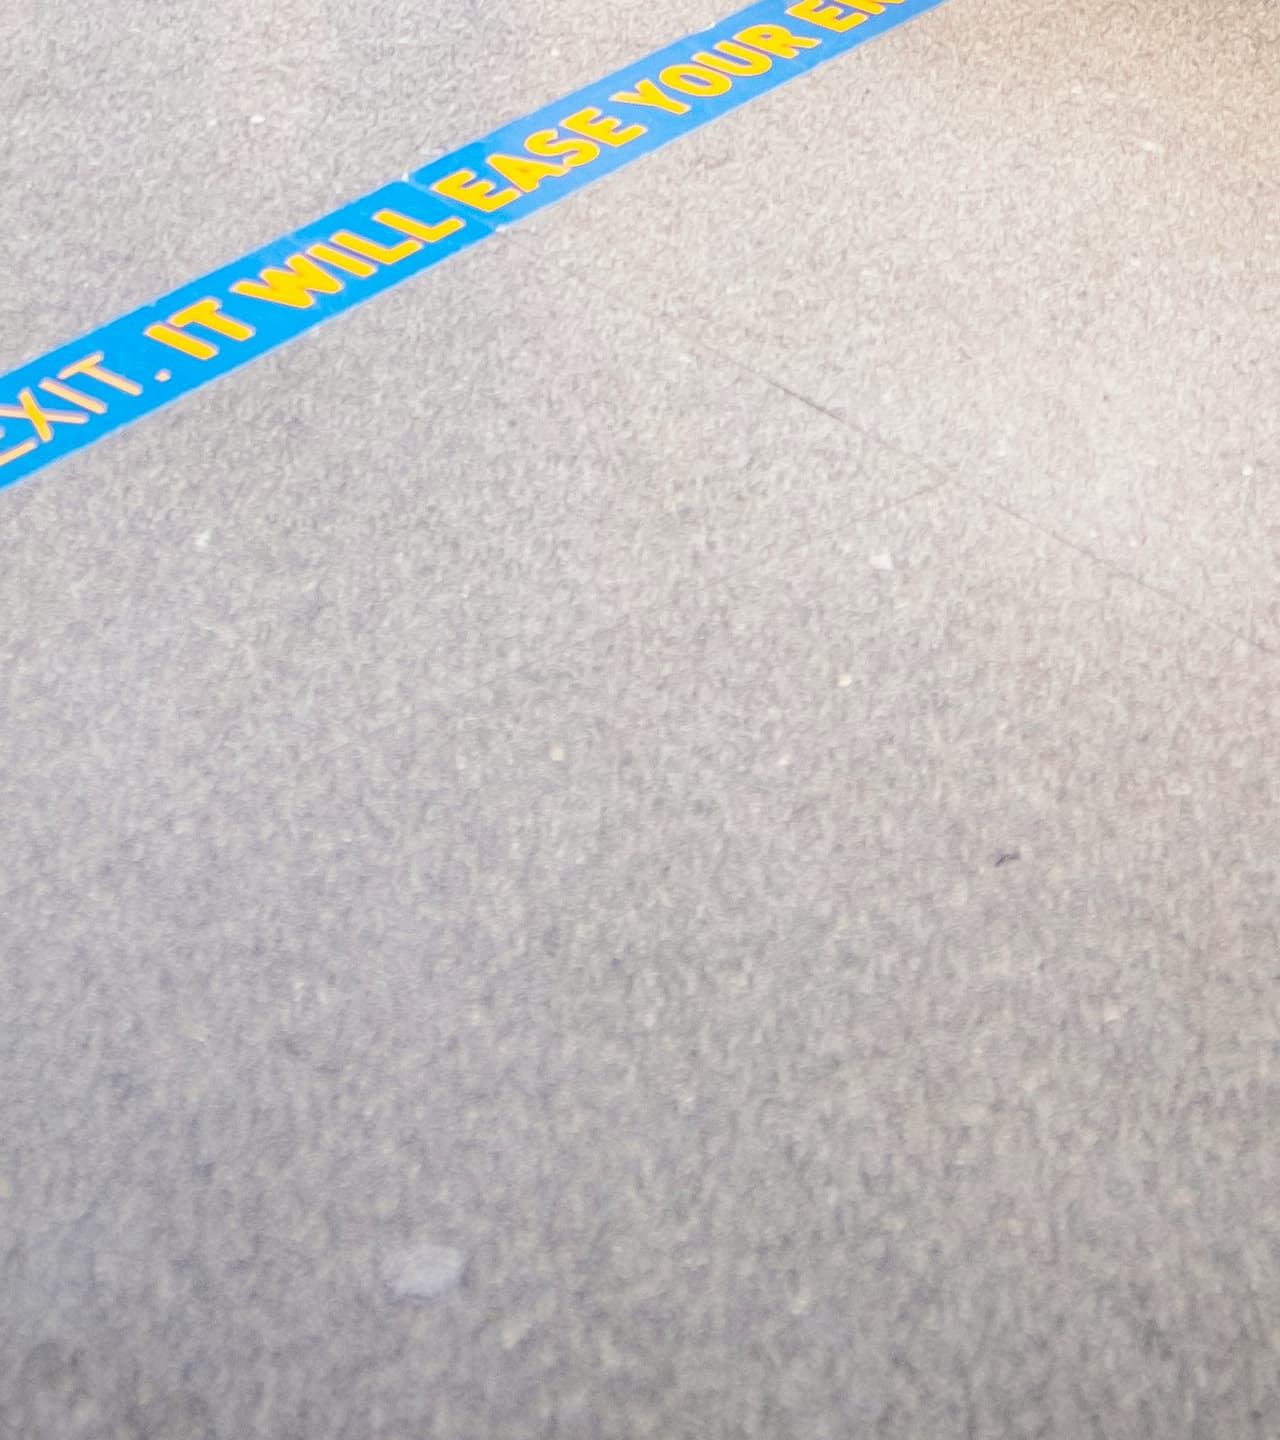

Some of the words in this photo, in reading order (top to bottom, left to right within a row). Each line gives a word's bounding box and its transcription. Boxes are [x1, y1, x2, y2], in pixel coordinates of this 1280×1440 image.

[143, 298, 256, 361] IT
[232, 208, 466, 310] WILL
[431, 105, 648, 214] EASE
[609, 22, 821, 115] YOUR
